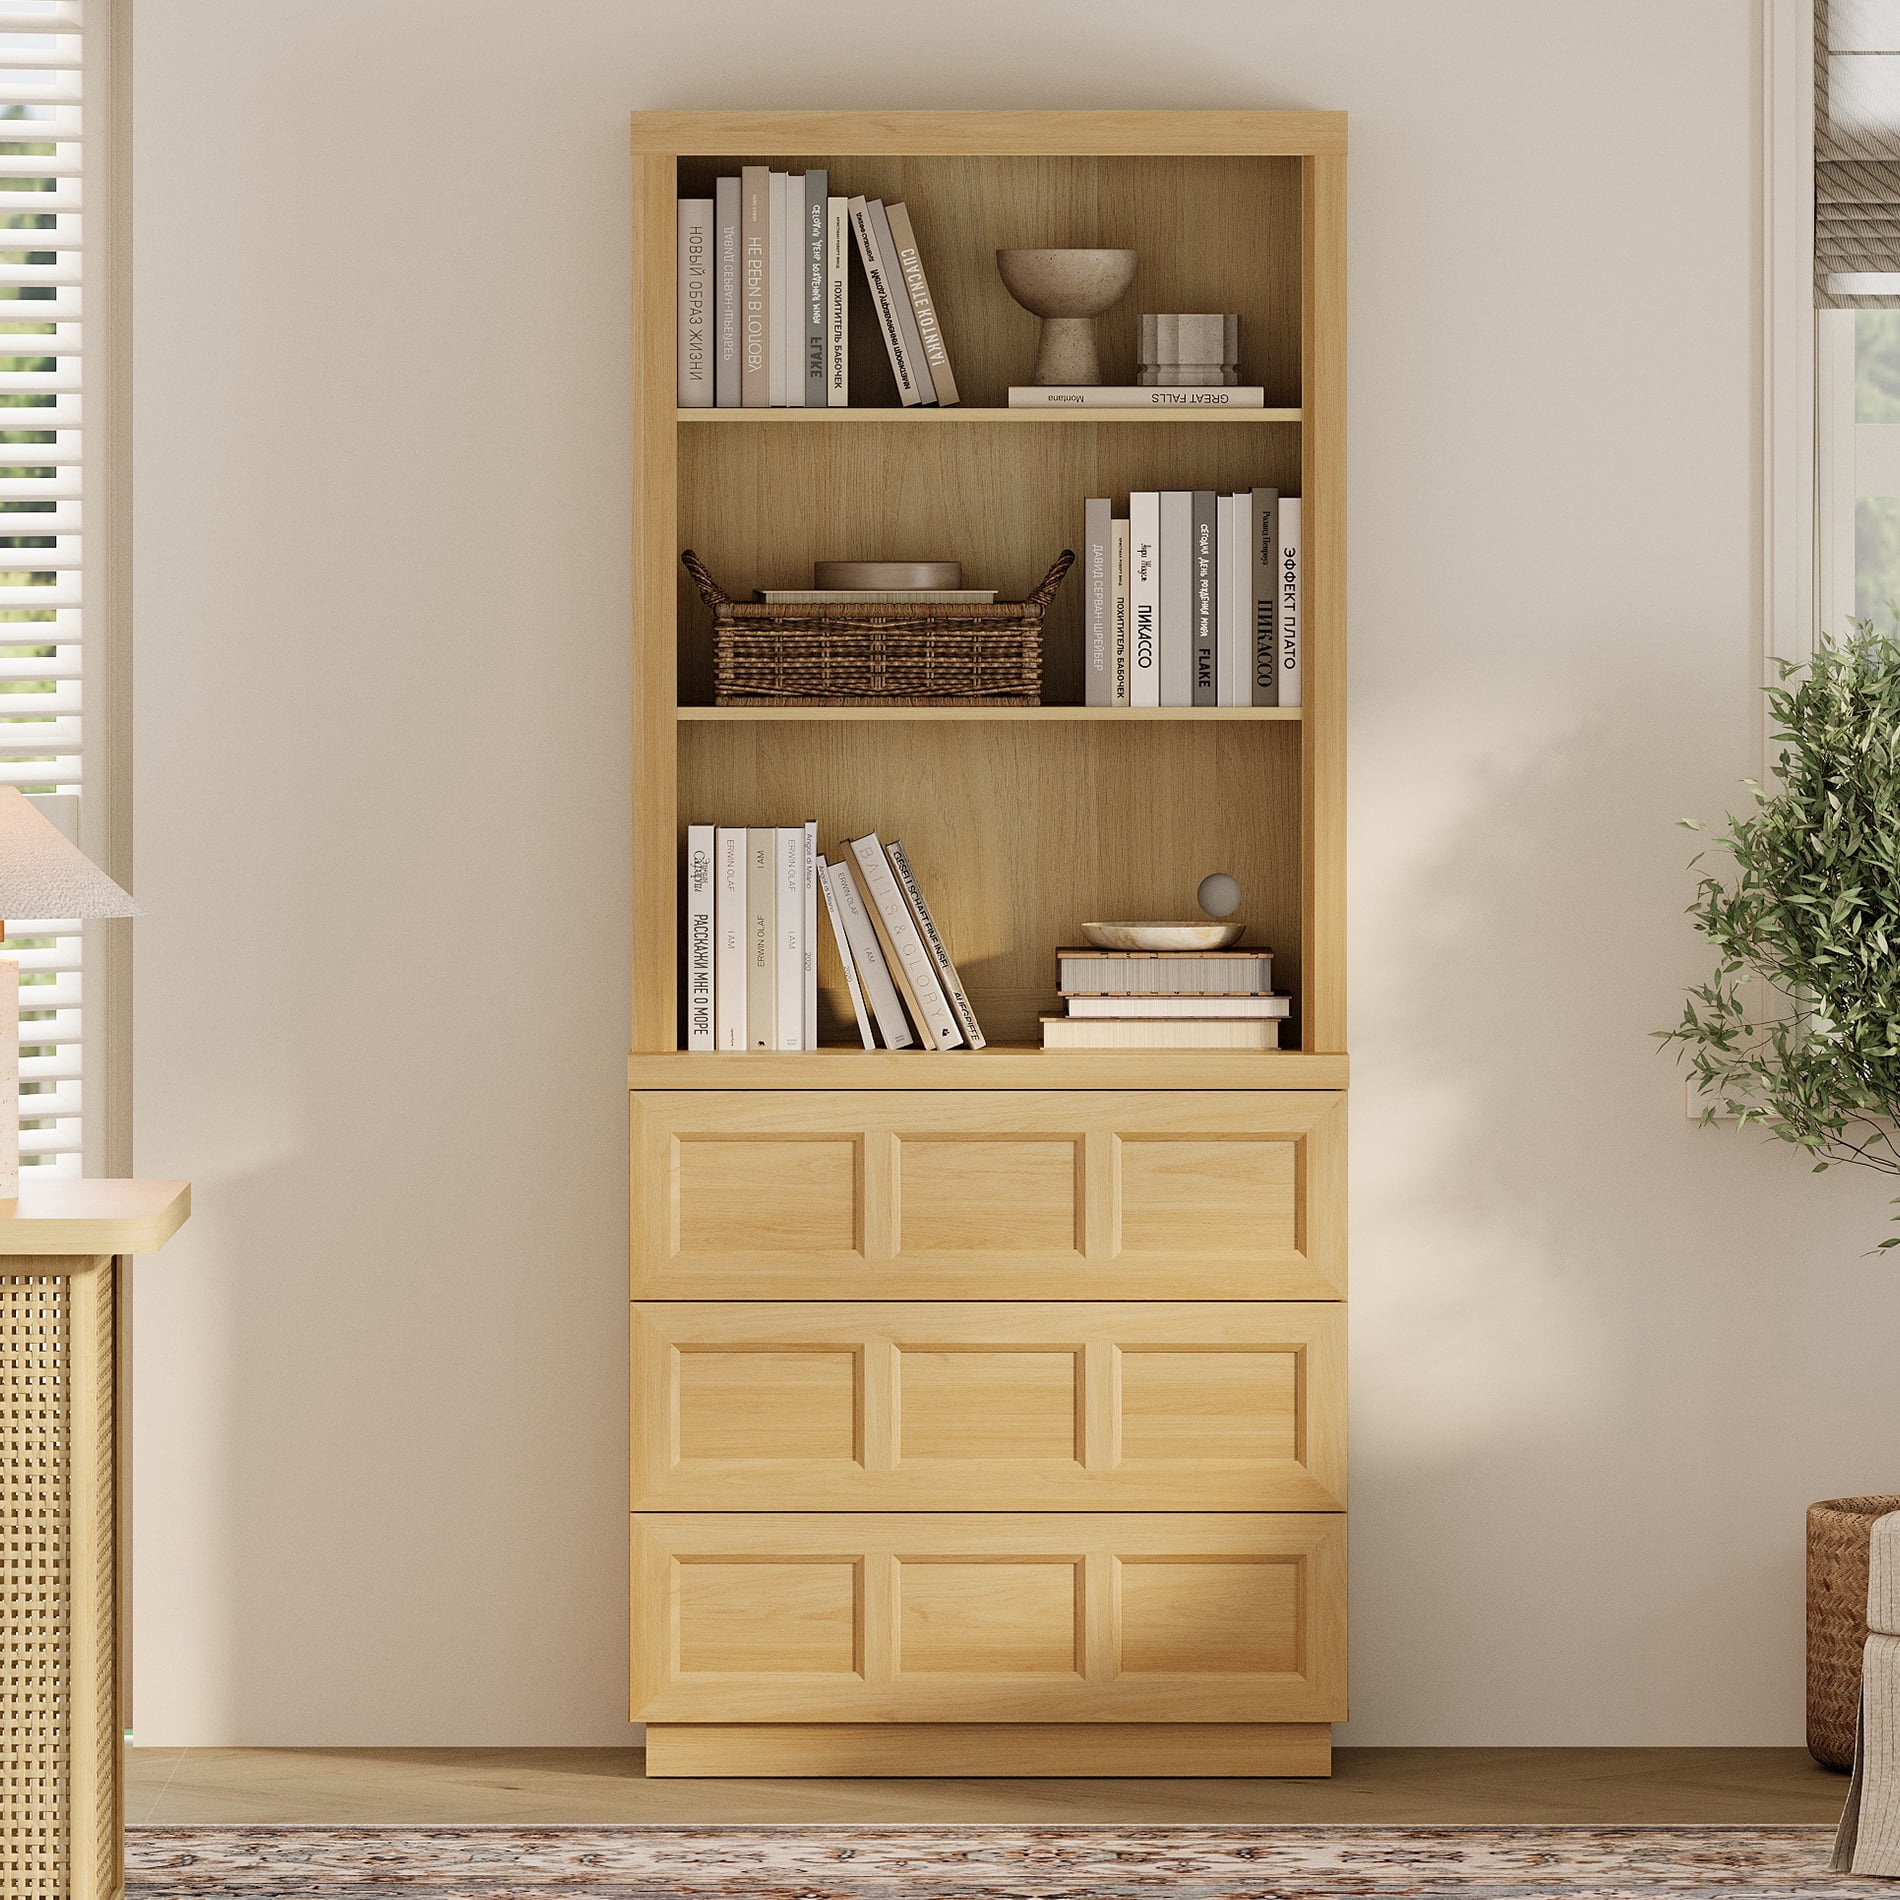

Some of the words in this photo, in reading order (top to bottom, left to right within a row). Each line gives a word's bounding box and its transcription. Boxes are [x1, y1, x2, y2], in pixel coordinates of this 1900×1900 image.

[689, 226, 706, 277] НОВЫЙ
[689, 280, 703, 325] ОБРАЗ
[834, 280, 843, 343] ПОХИТИТЕЛЬ
[689, 329, 703, 381] ЖИЗНИ
[834, 345, 843, 389] БАБОЧЕК
[1048, 394, 1084, 403] Montana
[1151, 393, 1187, 404] FALLS
[1190, 393, 1229, 404] GREAT
[1092, 544, 1104, 578] ДАВИД
[1283, 547, 1296, 611] ЭФФЕКТ
[1092, 581, 1104, 671] СЕРВАН-ШРЕЙБЕР
[1116, 597, 1125, 656] ПОХИТИТЕЛЬ
[1137, 605, 1152, 669] ПИКАССО
[1256, 599, 1273, 688] ПИКАССО
[1283, 616, 1296, 670] ПЛАТО
[1116, 657, 1125, 699] БАБОЧЕК
[1198, 648, 1211, 688] FLAKE
[727, 839, 735, 866] ERWIN
[757, 850, 765, 865] AM
[788, 839, 796, 866] ERWIN
[804, 833, 813, 856] Angoli
[727, 868, 735, 892] OLAF
[788, 868, 796, 892] OLAF
[837, 872, 851, 897] ERWIN
[843, 896, 858, 917] OLAF
[757, 915, 765, 937] OLAF
[693, 914, 708, 969] РАССКАЖИ
[727, 936, 735, 949] AM
[757, 939, 765, 967] ERWIN
[788, 936, 796, 949] AM
[804, 952, 812, 971] 2020
[865, 951, 876, 964] AM
[693, 972, 708, 994] МНЕ
[693, 1007, 708, 1036] МОРЕ
